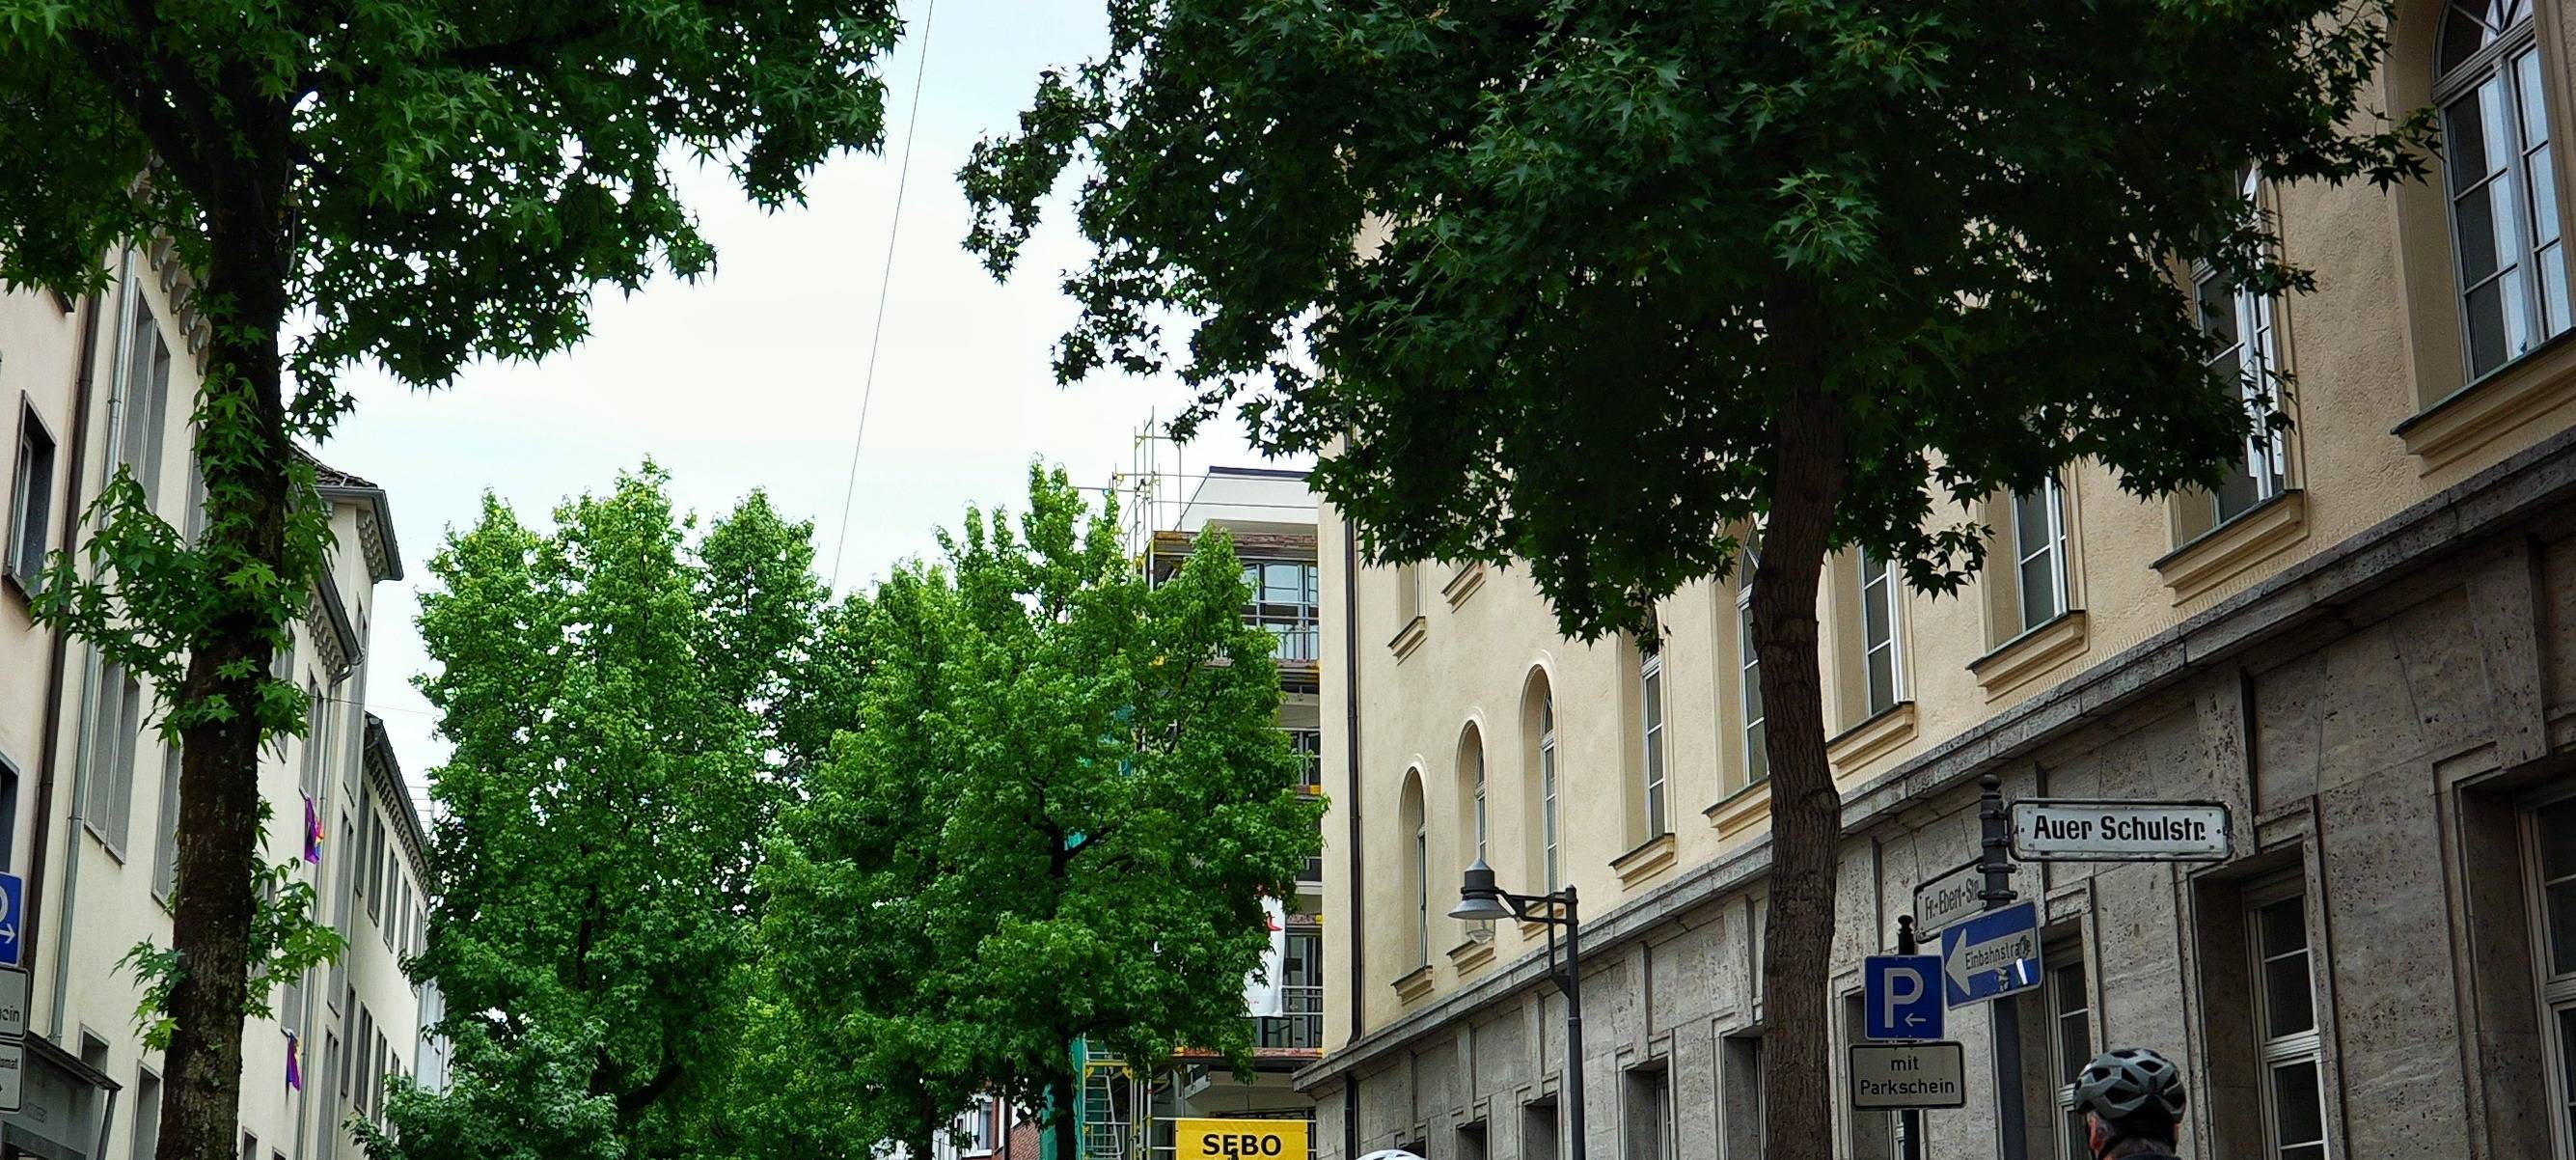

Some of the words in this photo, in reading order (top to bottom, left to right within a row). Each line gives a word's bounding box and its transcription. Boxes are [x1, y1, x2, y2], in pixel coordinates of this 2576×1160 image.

[2034, 815, 2093, 840] Auer
[2100, 815, 2206, 841] Schulstr.
[1883, 967, 1925, 1029] P
[1890, 1055, 1920, 1071] mit
[1860, 1078, 1955, 1095] Parkschein
[1202, 1133, 1282, 1156] SEBO
